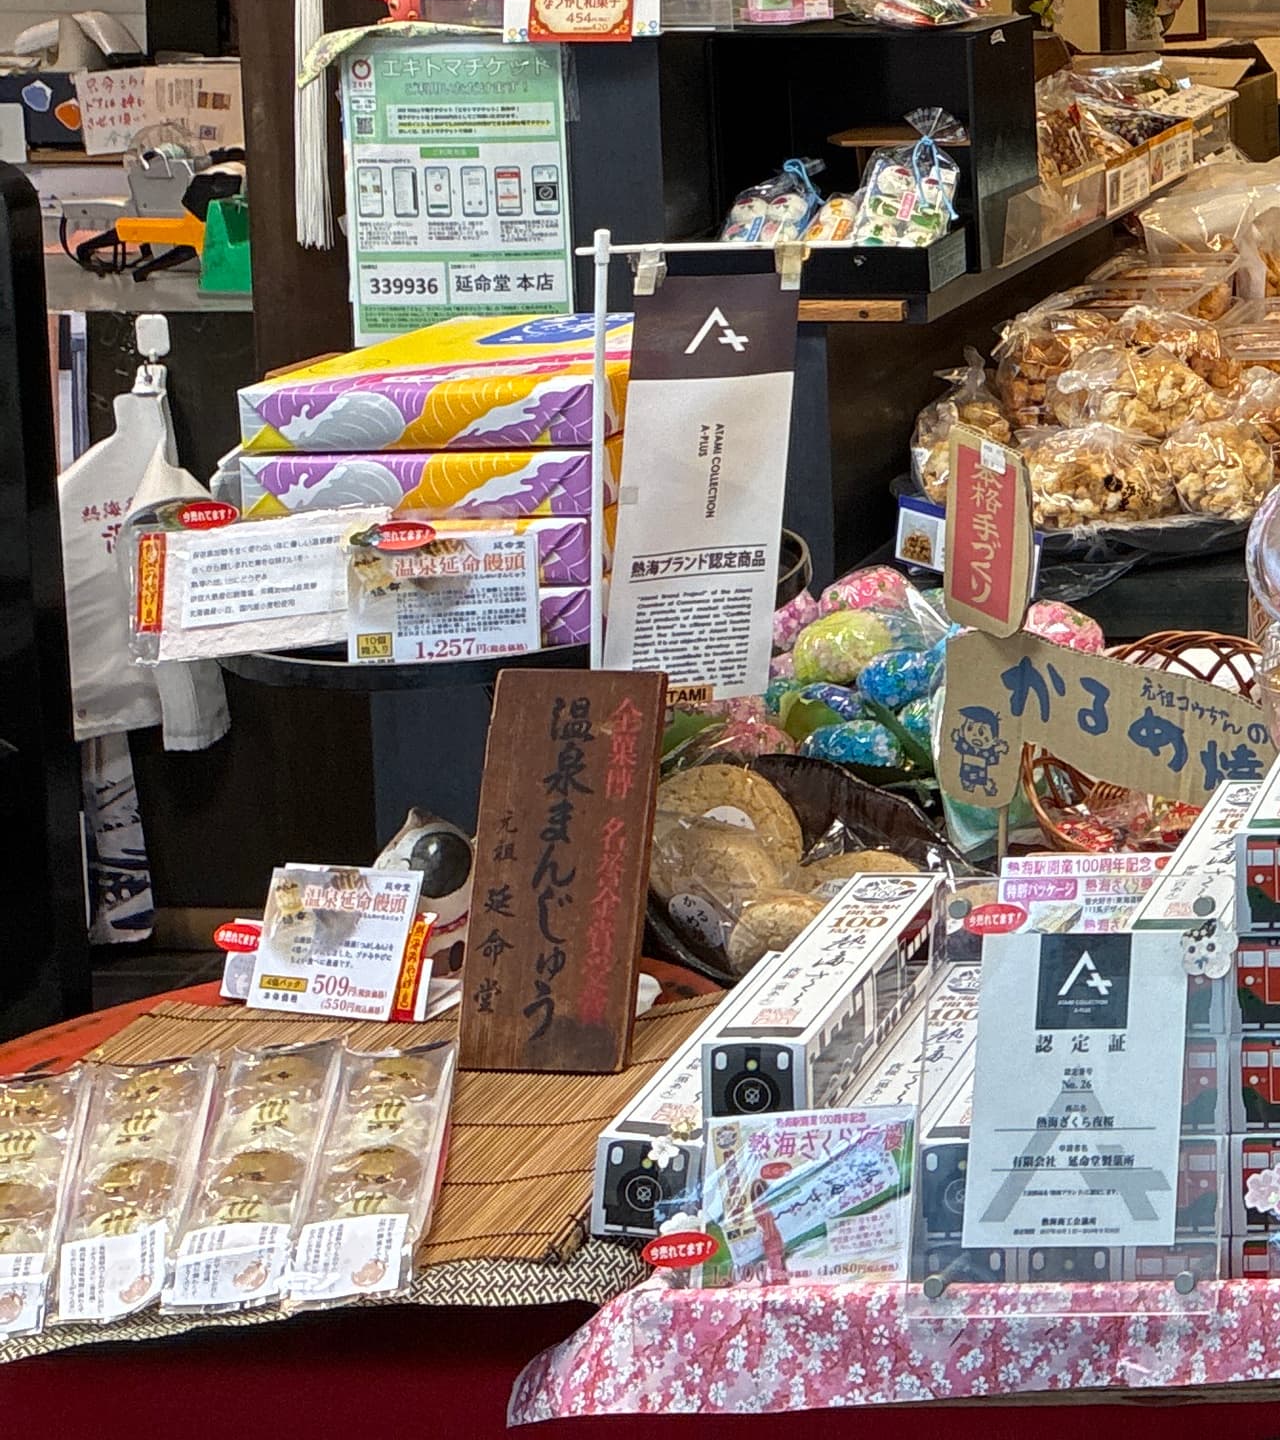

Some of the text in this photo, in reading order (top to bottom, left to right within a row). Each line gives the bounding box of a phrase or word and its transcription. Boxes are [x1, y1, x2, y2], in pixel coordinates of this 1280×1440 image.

[382, 55, 552, 78] エキトマチケット
[369, 276, 440, 295] 339936
[454, 271, 555, 294] 延命堂 本店
[704, 422, 726, 520] ATAMI COLLECTION
[381, 530, 430, 544] 売れてます!
[968, 461, 1004, 604] 本格手づくり
[395, 552, 527, 579] 温泉延命饅頭
[630, 546, 767, 578] 熱海ブランド認定商品
[415, 638, 476, 659] 1,257
[666, 687, 708, 703] TAMI
[522, 696, 598, 1041] 温泉まんじゅう
[1007, 857, 1152, 876] 熱海駅開業100周年記念
[304, 885, 410, 915] 温泉延命饅頭
[475, 809, 519, 1015] 元祖 延命堂
[827, 915, 889, 929] 100
[968, 912, 1022, 928] 今売れてます!
[312, 974, 349, 997] 509
[1034, 1033, 1128, 1054] 認定証
[649, 1242, 715, 1260] 今売れてます!
